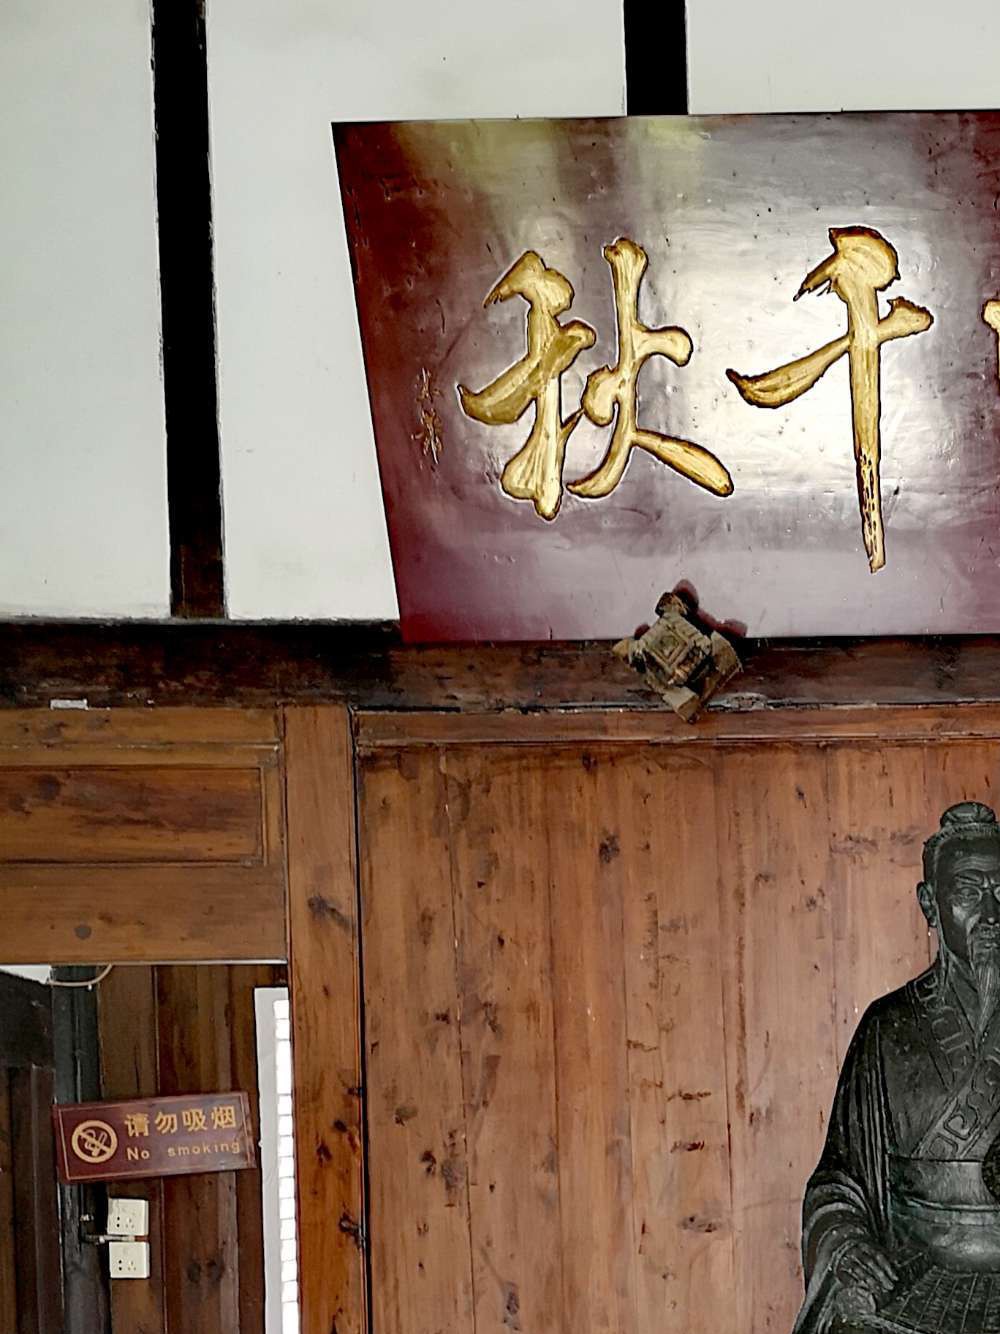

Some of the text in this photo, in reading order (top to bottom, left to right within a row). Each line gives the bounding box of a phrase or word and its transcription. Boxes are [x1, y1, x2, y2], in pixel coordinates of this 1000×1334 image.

[124, 1105, 237, 1138] 请勿吸烟
[126, 1138, 241, 1161] No smoking
